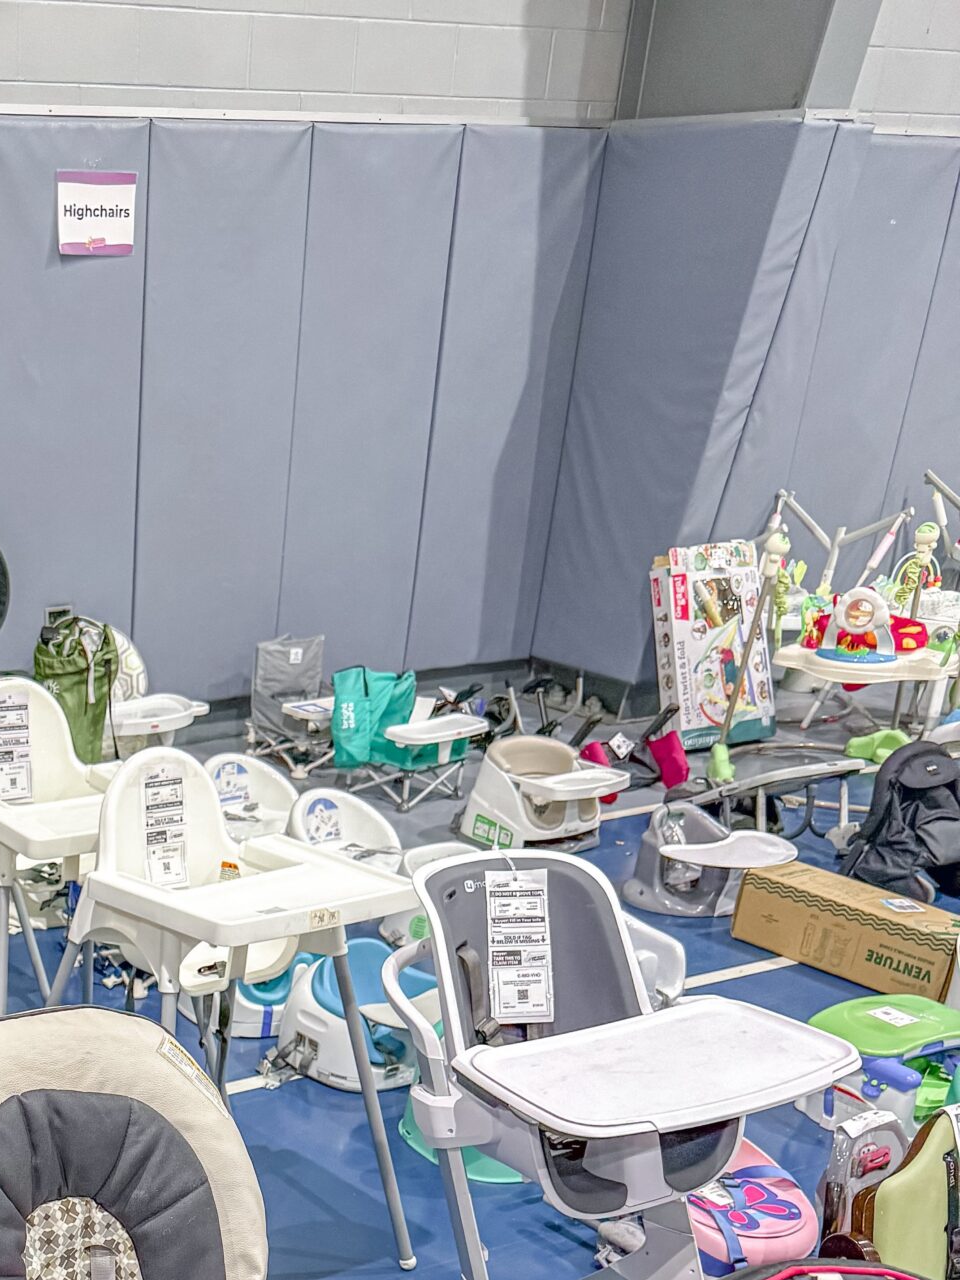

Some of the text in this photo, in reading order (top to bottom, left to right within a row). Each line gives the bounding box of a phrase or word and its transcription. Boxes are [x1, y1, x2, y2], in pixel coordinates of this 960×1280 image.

[63, 203, 130, 220] Highchairs
[677, 640, 685, 660] fold
[680, 671, 689, 695] twist
[684, 734, 721, 747] nfantino
[865, 949, 931, 984] VENTURE
